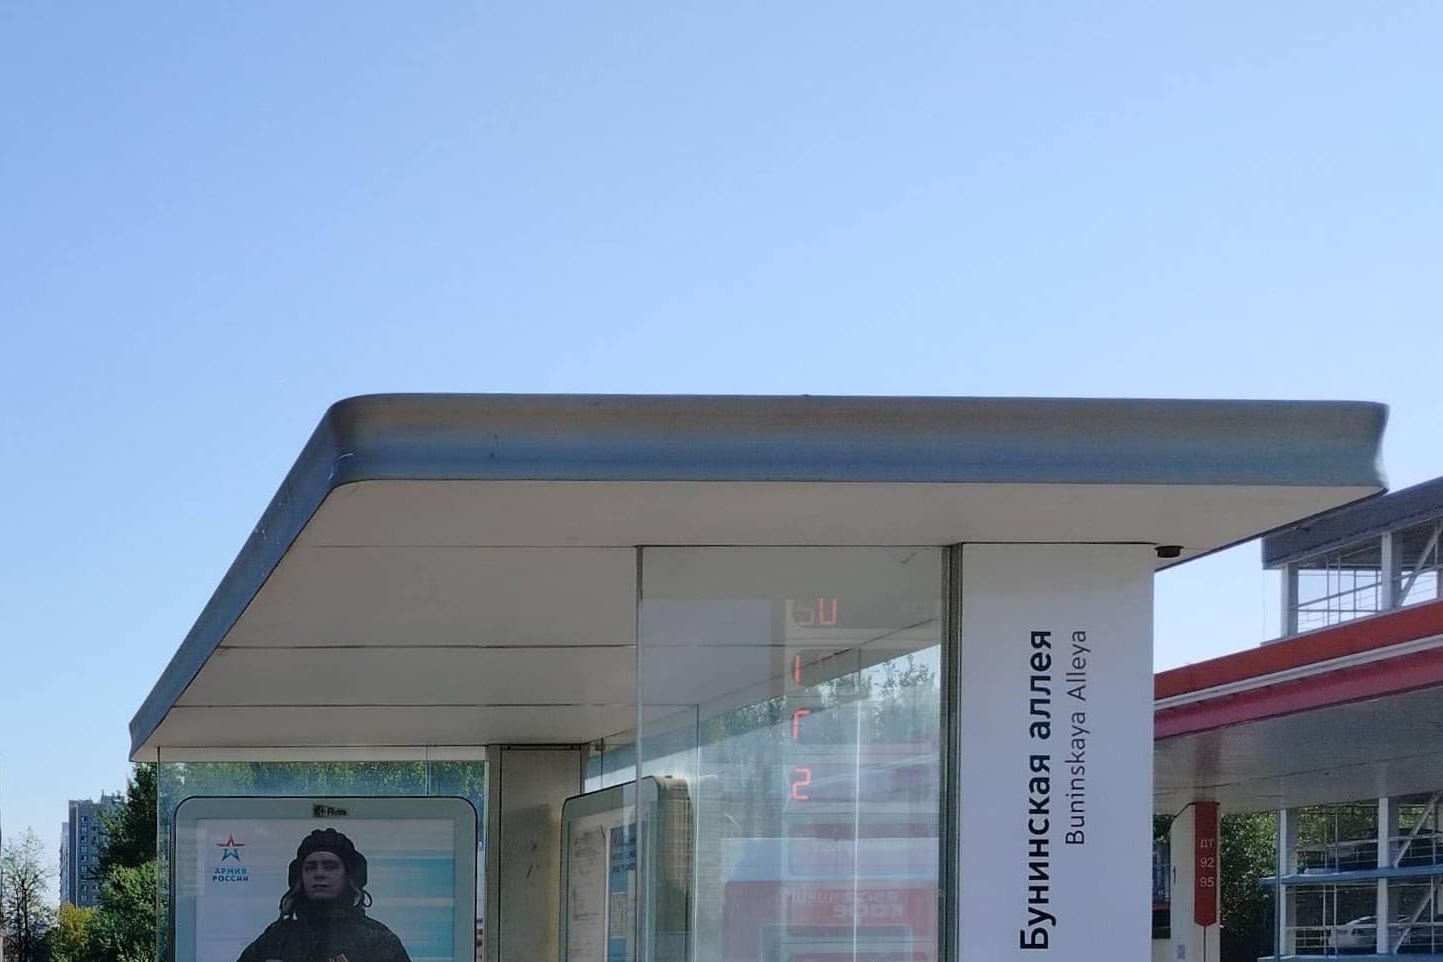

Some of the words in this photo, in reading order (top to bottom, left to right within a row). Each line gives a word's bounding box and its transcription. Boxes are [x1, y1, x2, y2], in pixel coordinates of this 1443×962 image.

[1030, 630, 1052, 740] аллея
[1065, 630, 1091, 701] Alleya
[1065, 711, 1090, 845] Buninskaya
[1019, 754, 1056, 950] Бунинская
[1200, 839, 1213, 848] ДТ
[1200, 857, 1214, 868] 92
[1199, 876, 1214, 887] 95
